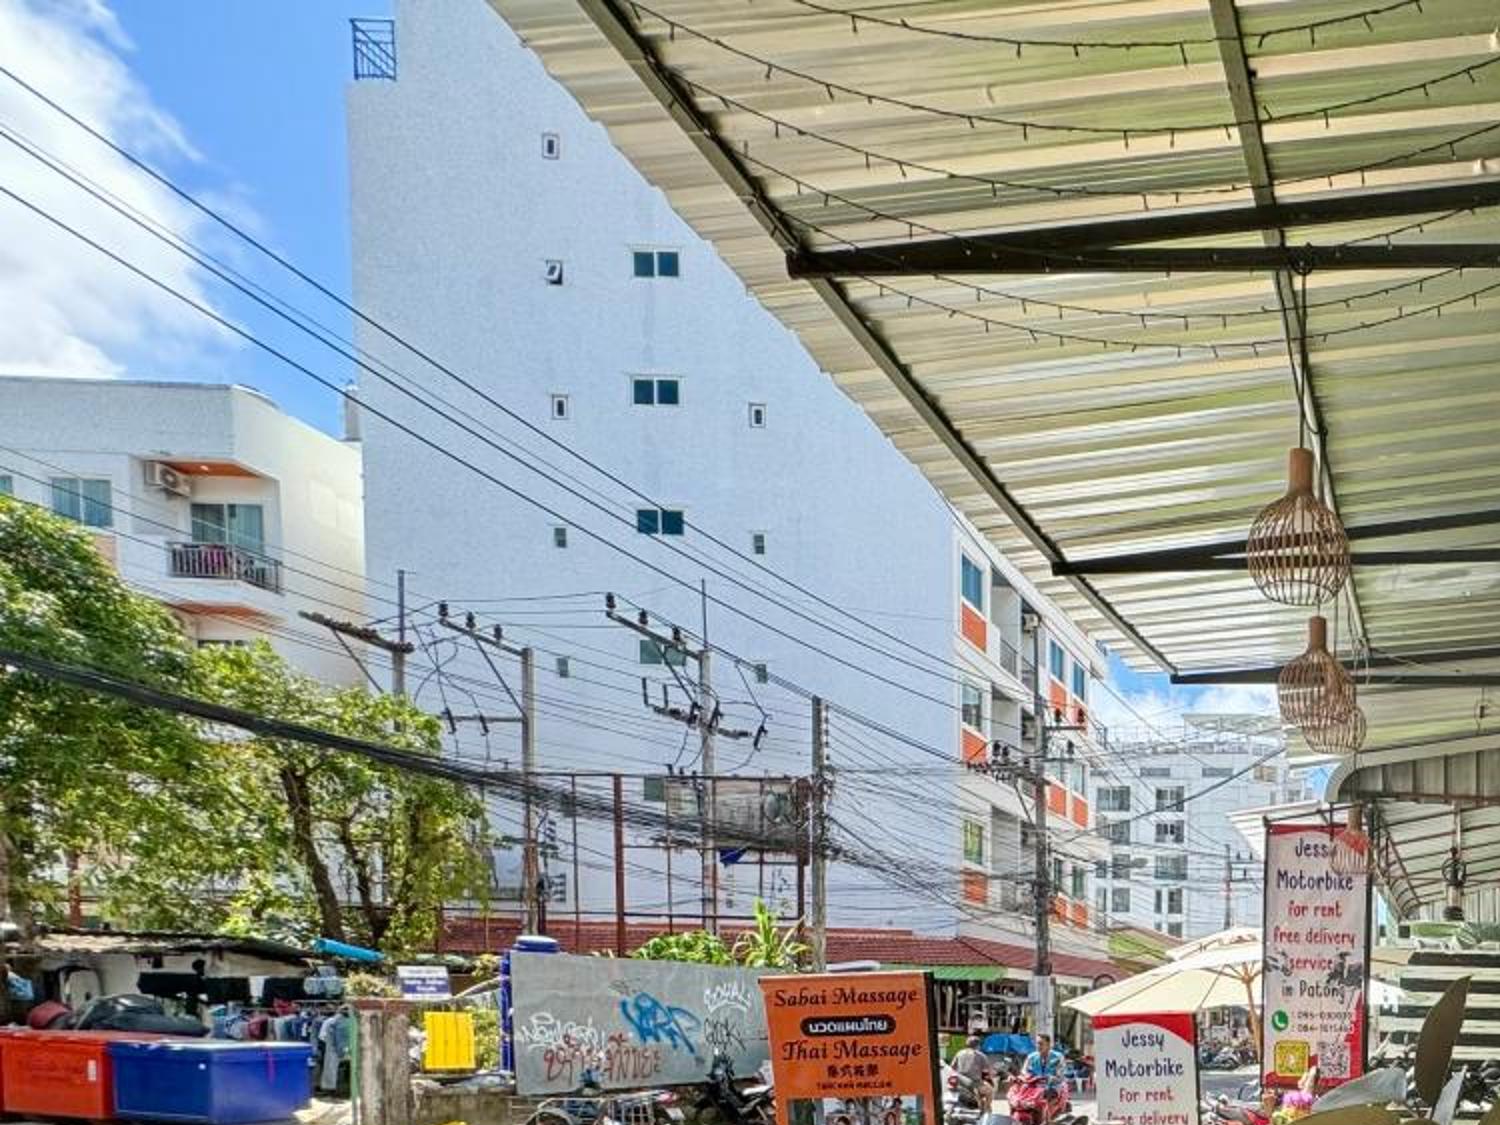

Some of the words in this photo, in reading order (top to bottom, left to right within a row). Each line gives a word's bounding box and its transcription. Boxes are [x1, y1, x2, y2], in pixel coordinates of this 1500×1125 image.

[1276, 869, 1354, 891] Motorbike
[1288, 900, 1309, 918] for
[1314, 900, 1343, 918] rent
[1273, 926, 1301, 944] free
[1305, 927, 1356, 949] delivery
[1289, 956, 1334, 971] service
[774, 986, 827, 1008] Sabai
[832, 986, 919, 1010] Massage
[1299, 979, 1346, 1004] Patong
[1121, 1029, 1166, 1052] Jessy
[782, 1040, 828, 1061] Thai
[833, 1039, 923, 1065] Massage
[1105, 1058, 1184, 1078] Motorbike
[1145, 1087, 1174, 1103] rent
